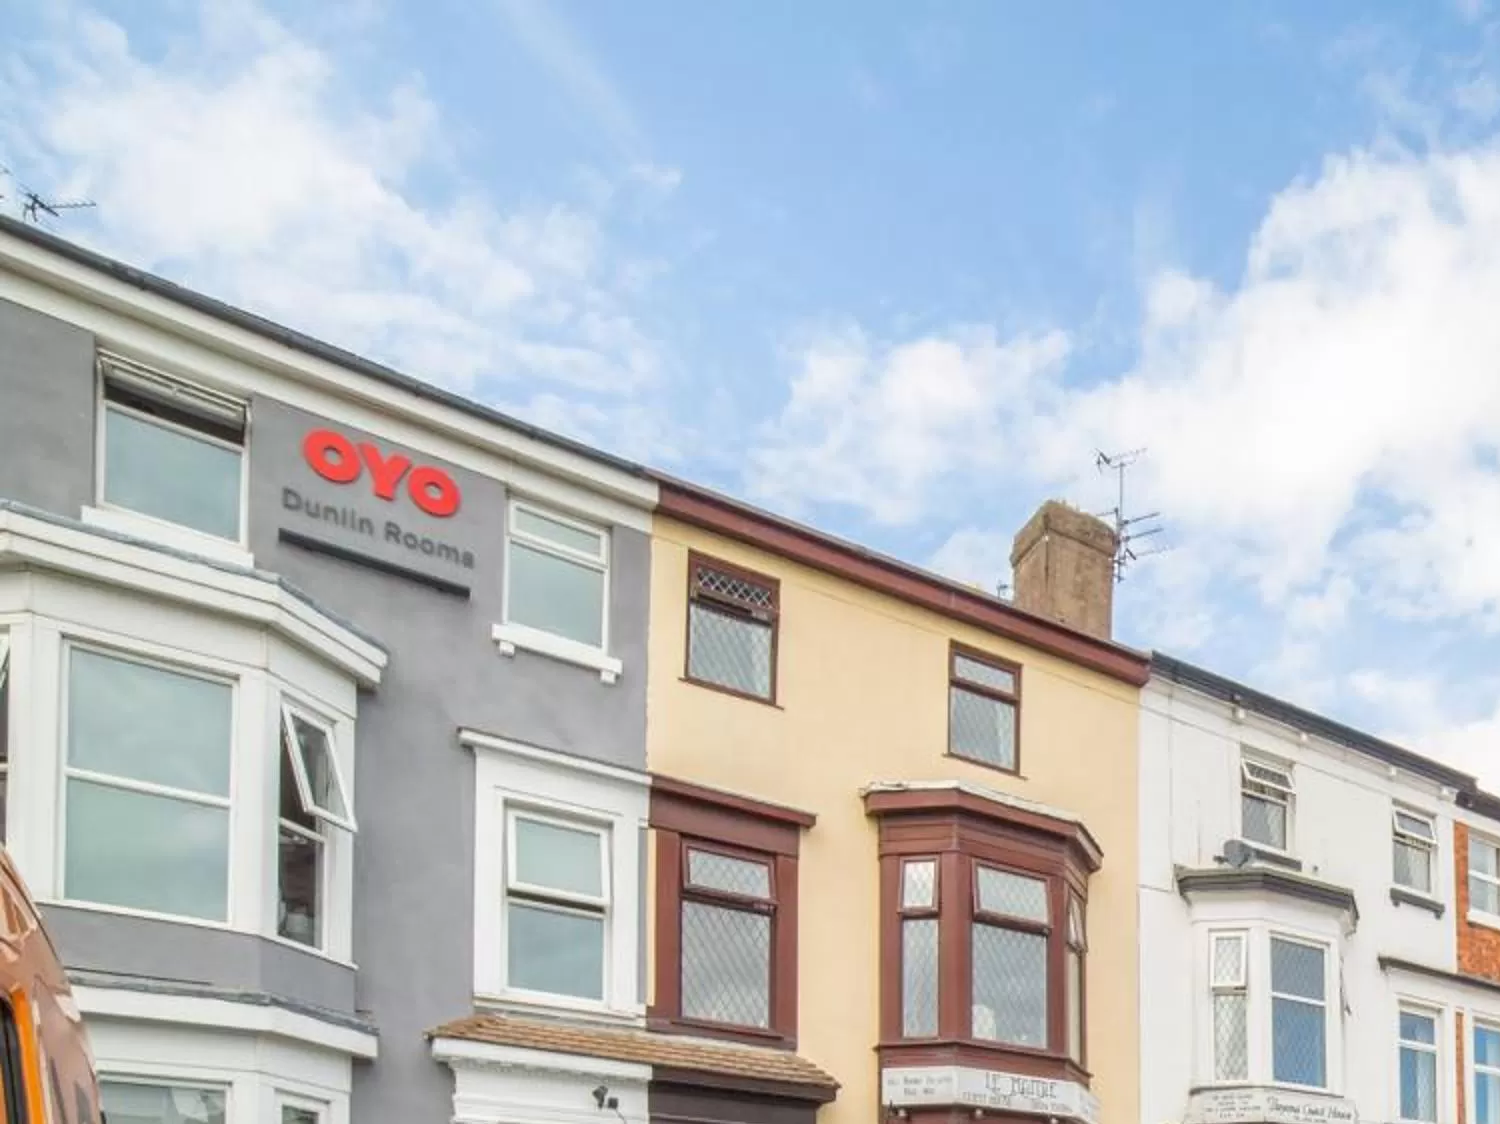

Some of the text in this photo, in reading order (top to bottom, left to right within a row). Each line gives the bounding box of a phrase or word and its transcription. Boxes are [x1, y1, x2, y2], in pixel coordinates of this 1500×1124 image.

[303, 427, 461, 518] OYO
[282, 486, 475, 569] Dunlin Rooms
